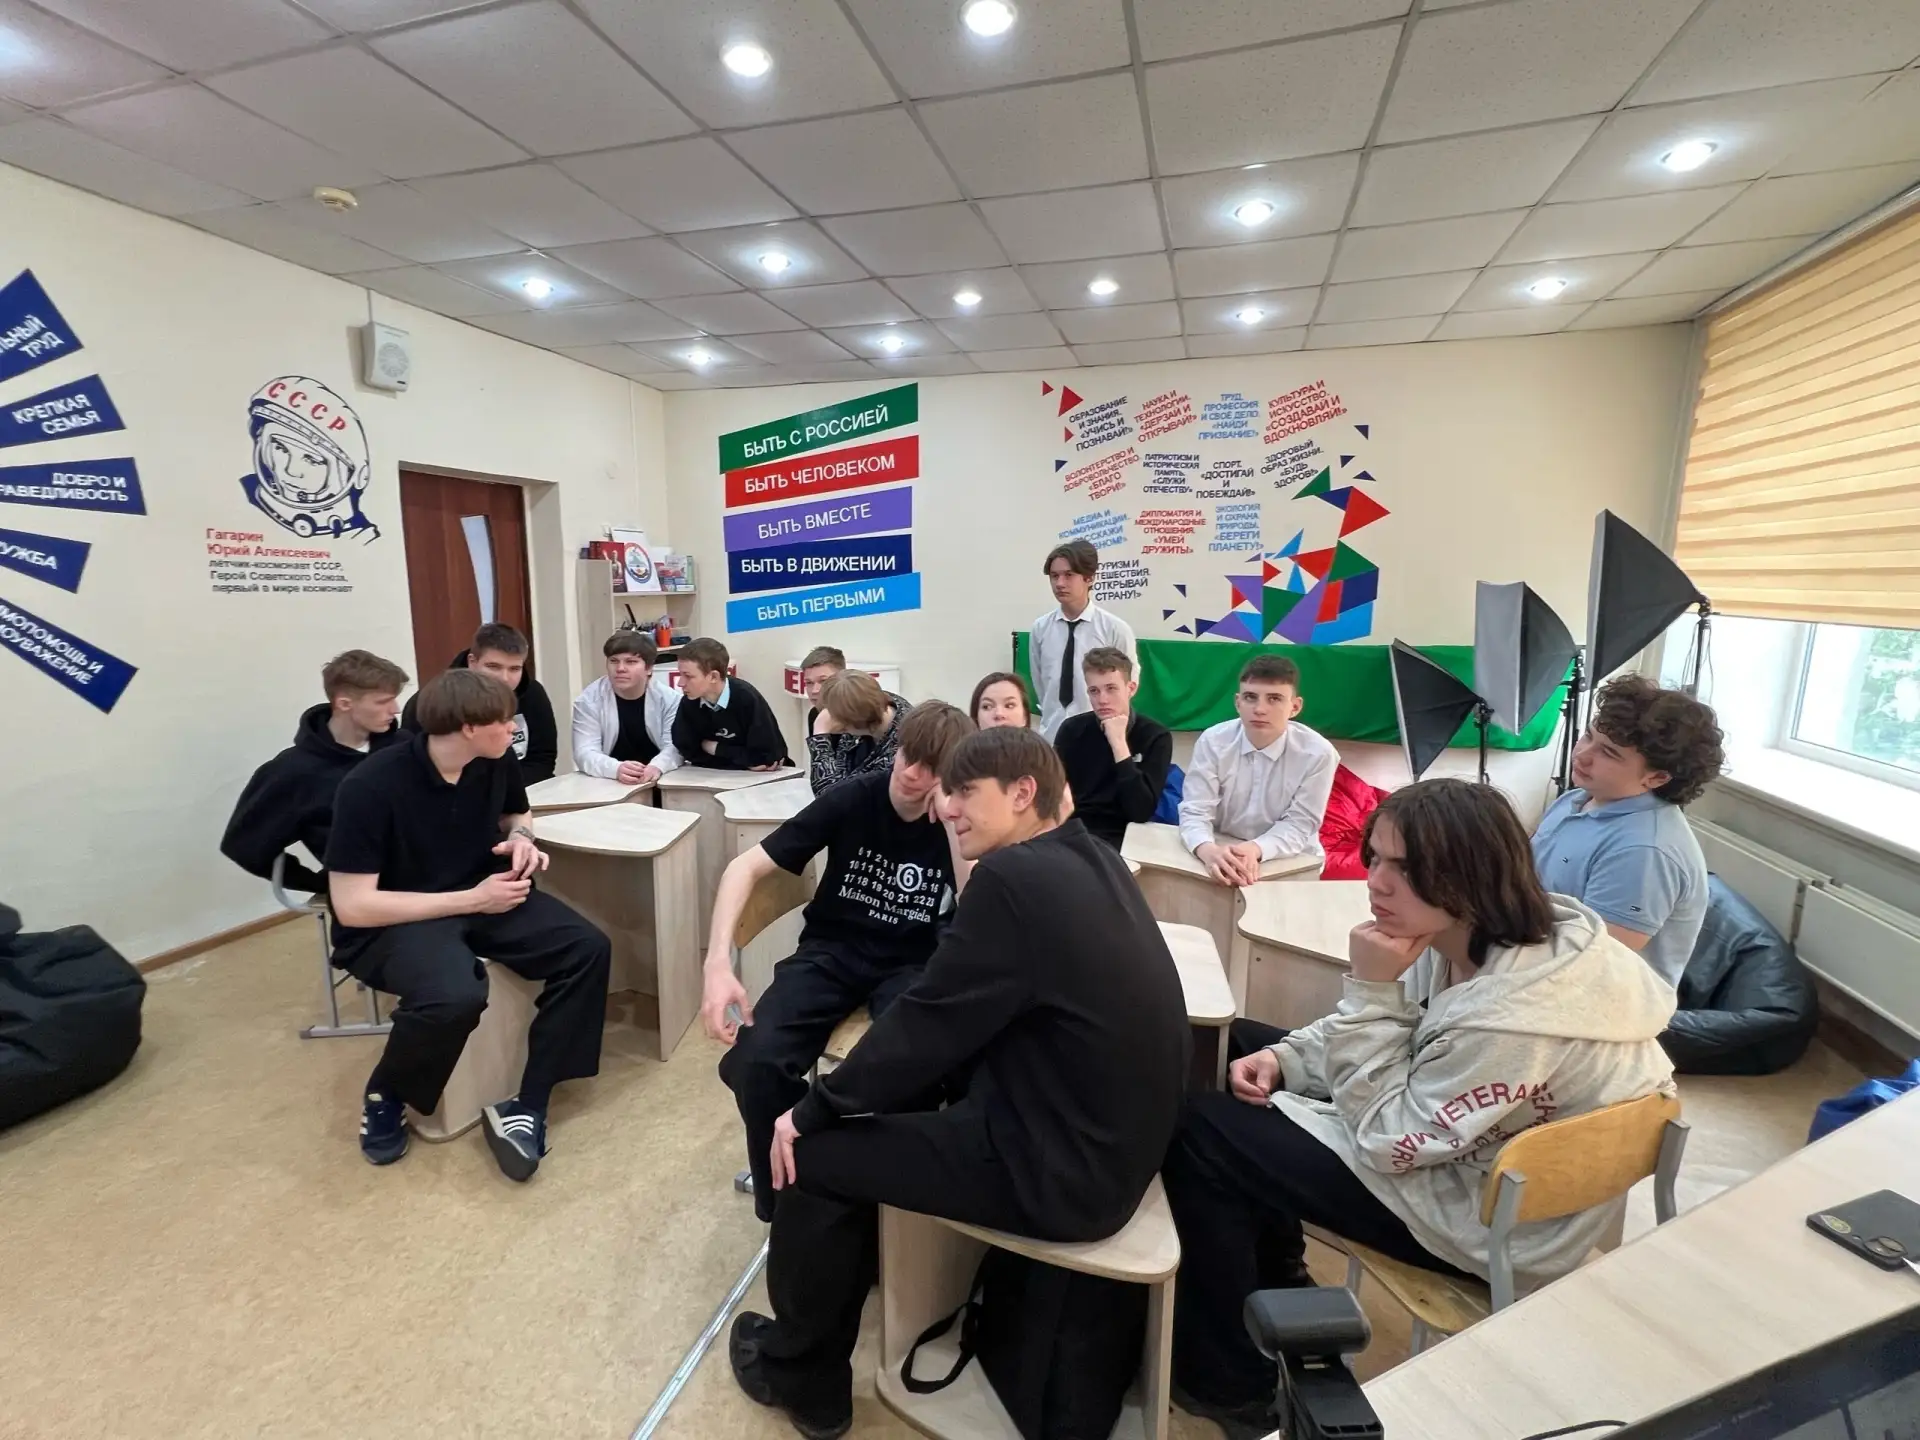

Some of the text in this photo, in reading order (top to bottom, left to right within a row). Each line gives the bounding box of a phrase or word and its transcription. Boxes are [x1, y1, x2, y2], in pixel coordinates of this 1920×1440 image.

[18, 331, 64, 358] ТРУД
[1142, 390, 1178, 410] НАУКА И
[1268, 380, 1325, 408] КУЛЬТУРА И
[12, 394, 92, 424] КРЕПКАЯ
[268, 382, 347, 432] СССР
[1068, 396, 1128, 424] ОБРАЗОВАНИЕ
[1140, 404, 1192, 430] «ДЕРЗАЙ И
[1266, 395, 1340, 432] «СОЗДАВАЙ И
[41, 410, 102, 434] СЕМЬЯ
[743, 404, 888, 458] БЫТЬ С РОССИЕЙ
[1080, 417, 1125, 439] «УЧИСЬ И
[1265, 439, 1314, 464] ЗДОРОВЫЙ
[744, 453, 896, 494] БЫТЬ ЧЕЛОВЕКОМ
[1064, 446, 1134, 482] ВОЛОНТЕРСТВО И
[1200, 468, 1254, 480] «ДОСТИГАЙ
[1260, 459, 1288, 474] ОБРАЗ
[1280, 463, 1308, 476] «БУДЬ
[52, 472, 127, 488] ДОБРО И
[1089, 472, 1122, 490] «БЛАГО
[758, 502, 872, 540] БЫТЬ ВМЕСТЕ
[1134, 518, 1206, 526] МЕЖДУНАРОДНЫЕ
[206, 528, 264, 542] Гагарин
[1154, 536, 1185, 544] «УМЕЙ
[207, 544, 331, 558] Юрий Алексеевич
[210, 570, 246, 581] Герой
[250, 572, 312, 581] Советского
[741, 556, 896, 574] БЫТЬ В ДВИЖЕНИИ
[212, 584, 259, 594] первый
[272, 585, 300, 594] мире
[757, 586, 886, 622] БЫТЬ ПЕРВЫМИ
[88, 661, 104, 674] И
[874, 854, 882, 862] 2
[861, 862, 874, 873] 11
[876, 868, 886, 880] 12
[844, 874, 856, 883] 17
[857, 876, 868, 886] 18
[882, 889, 894, 900] 20
[897, 894, 910, 903] 21
[913, 896, 924, 905] 22
[838, 885, 931, 923] Maison Margiela
[868, 909, 899, 924] PARIS
